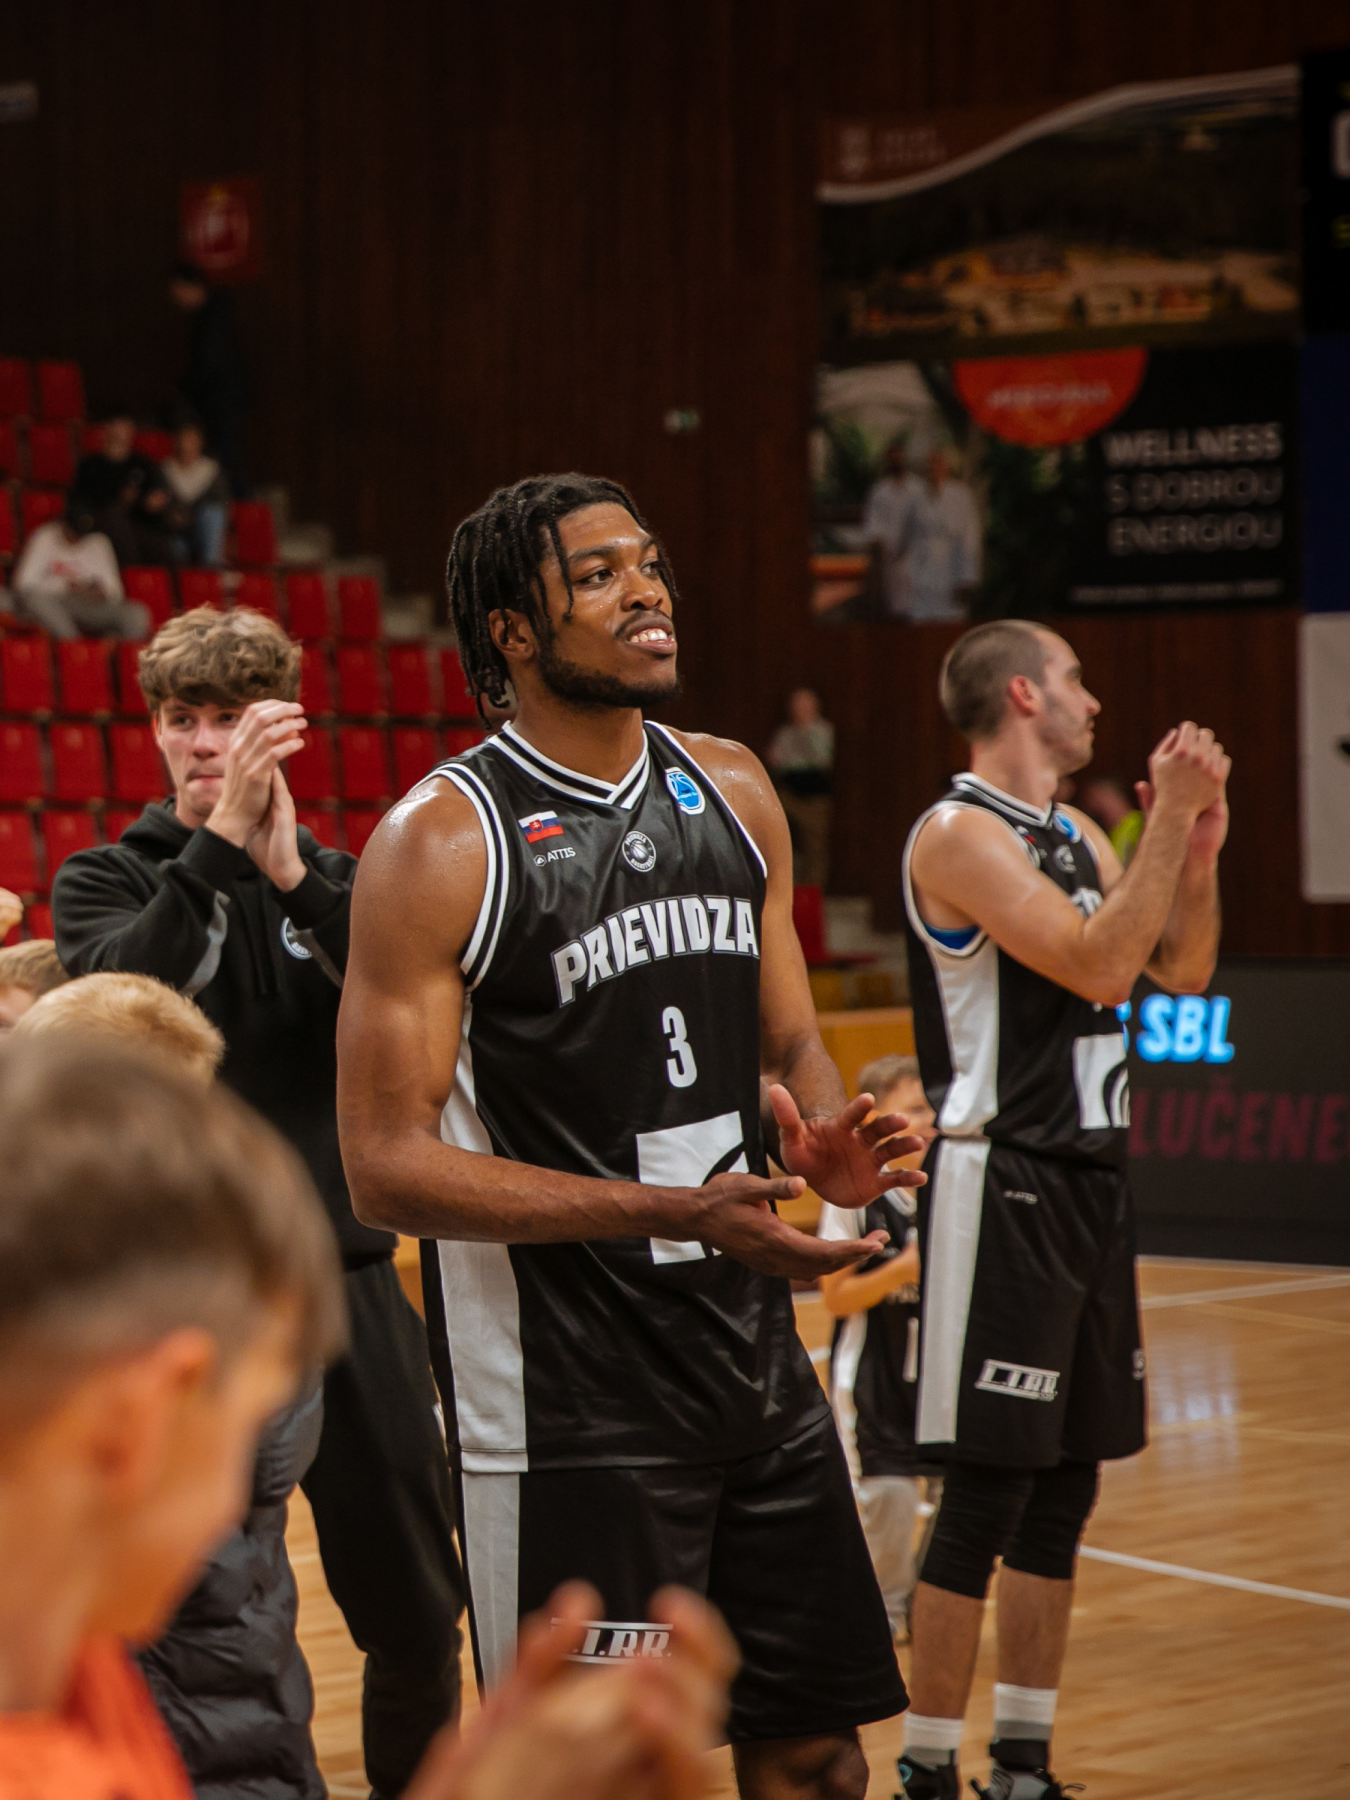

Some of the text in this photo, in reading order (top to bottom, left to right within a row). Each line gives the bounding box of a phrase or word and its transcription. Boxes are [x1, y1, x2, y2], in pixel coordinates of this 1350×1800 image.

[1104, 422, 1282, 467] WELLNESS
[1132, 468, 1283, 511] DOBROU
[1107, 511, 1283, 555] ENERGIOU
[547, 847, 576, 862] ATTIS
[551, 894, 760, 1008] PRIEVIDZA
[661, 1006, 698, 1088] 3
[1135, 993, 1236, 1064] SBL
[1128, 1074, 1350, 1162] LUČENE
[572, 1628, 672, 1658] .I.R.R.
